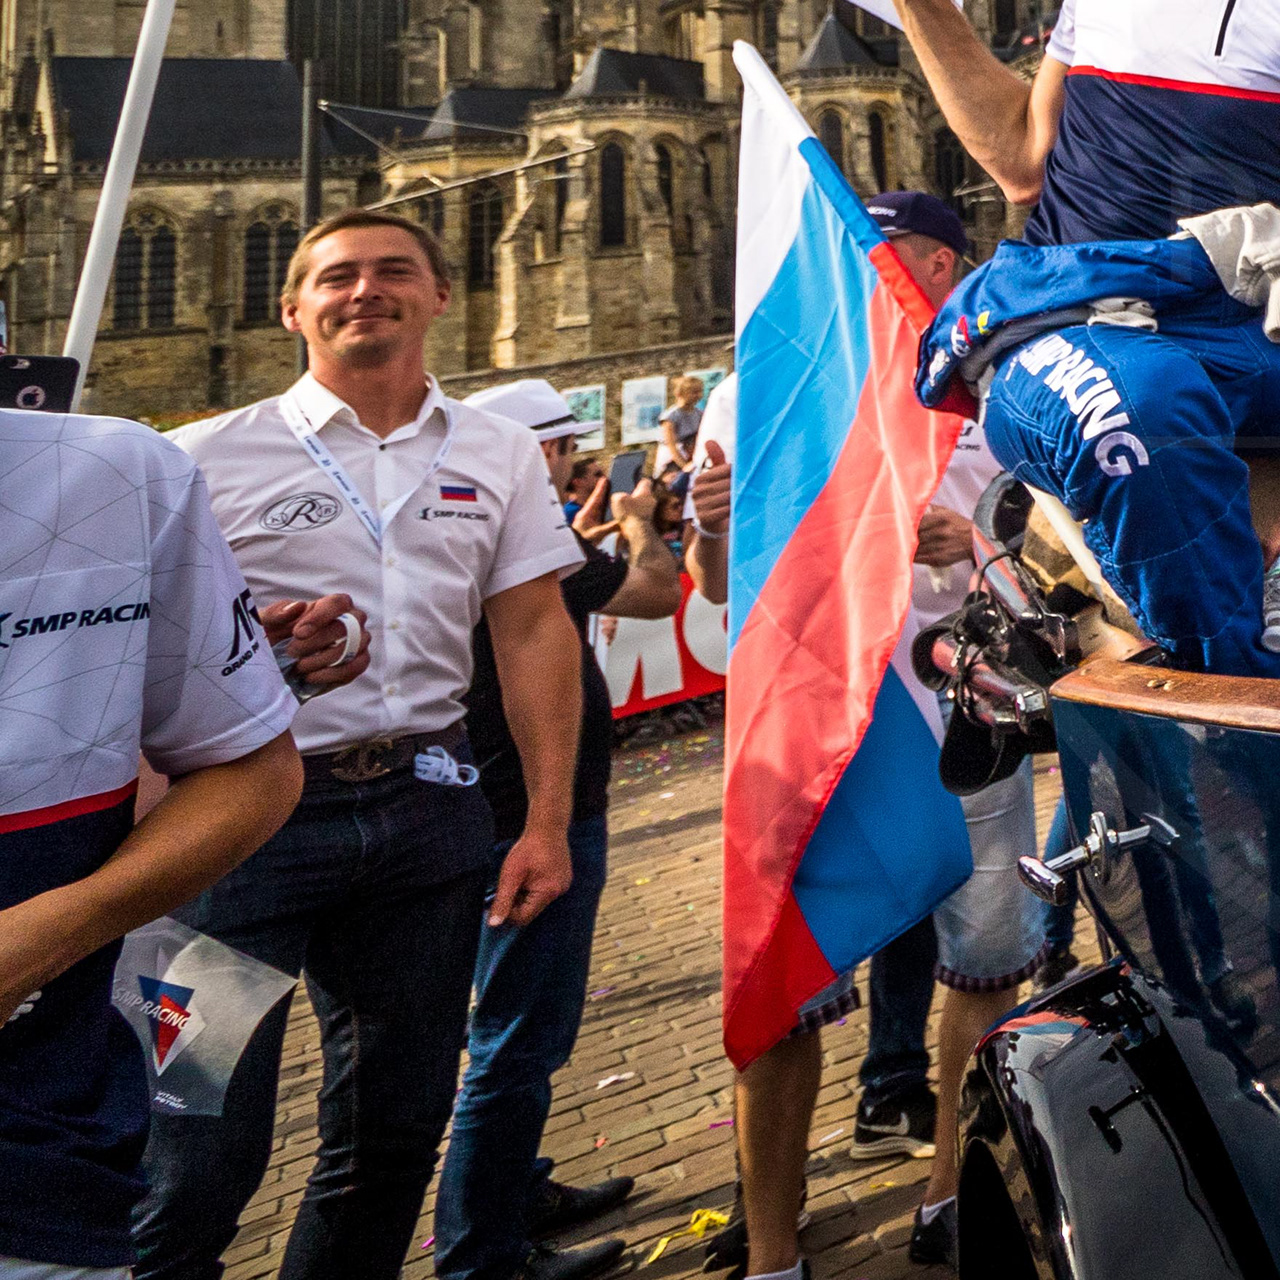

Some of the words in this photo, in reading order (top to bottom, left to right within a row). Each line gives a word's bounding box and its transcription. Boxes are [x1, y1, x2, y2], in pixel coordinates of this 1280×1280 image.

[1042, 348, 1150, 478] RACING
[11, 612, 78, 639] SMP
[112, 985, 144, 1009] SMP
[139, 1000, 192, 1031] RACING
